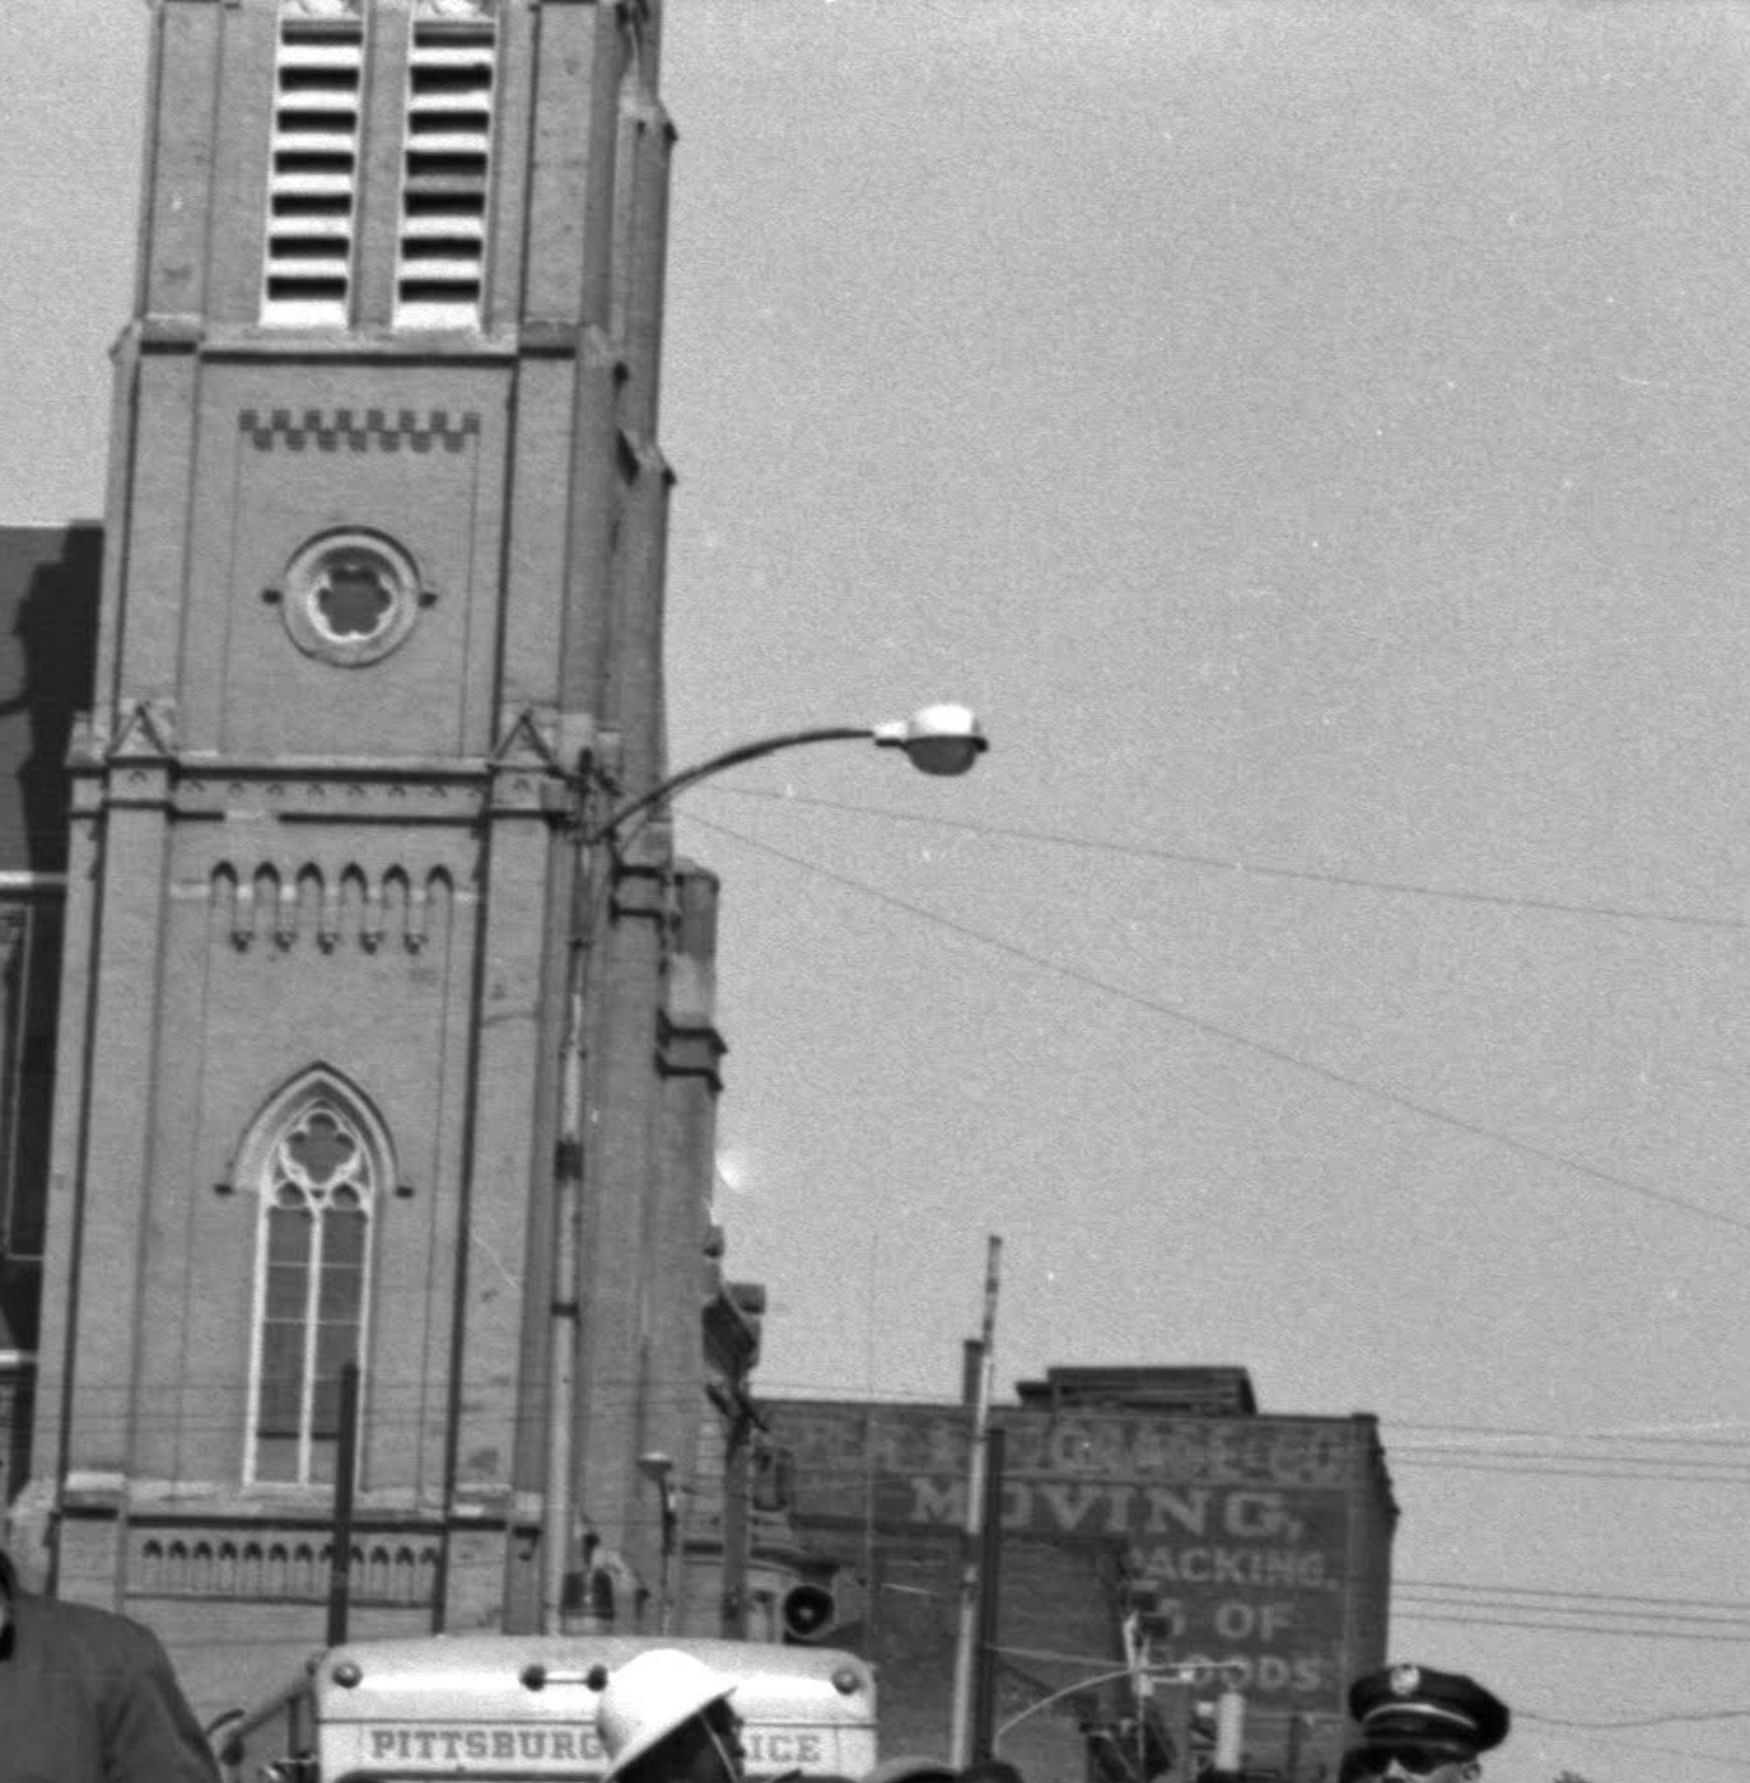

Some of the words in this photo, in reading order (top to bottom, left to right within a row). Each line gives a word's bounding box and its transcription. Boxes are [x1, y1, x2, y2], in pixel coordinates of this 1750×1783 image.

[909, 1476, 1303, 1543] MOVING,
[1215, 1603, 1295, 1642] OF
[1158, 1650, 1322, 1692] OODS
[371, 1730, 602, 1760] PITTSBURG
